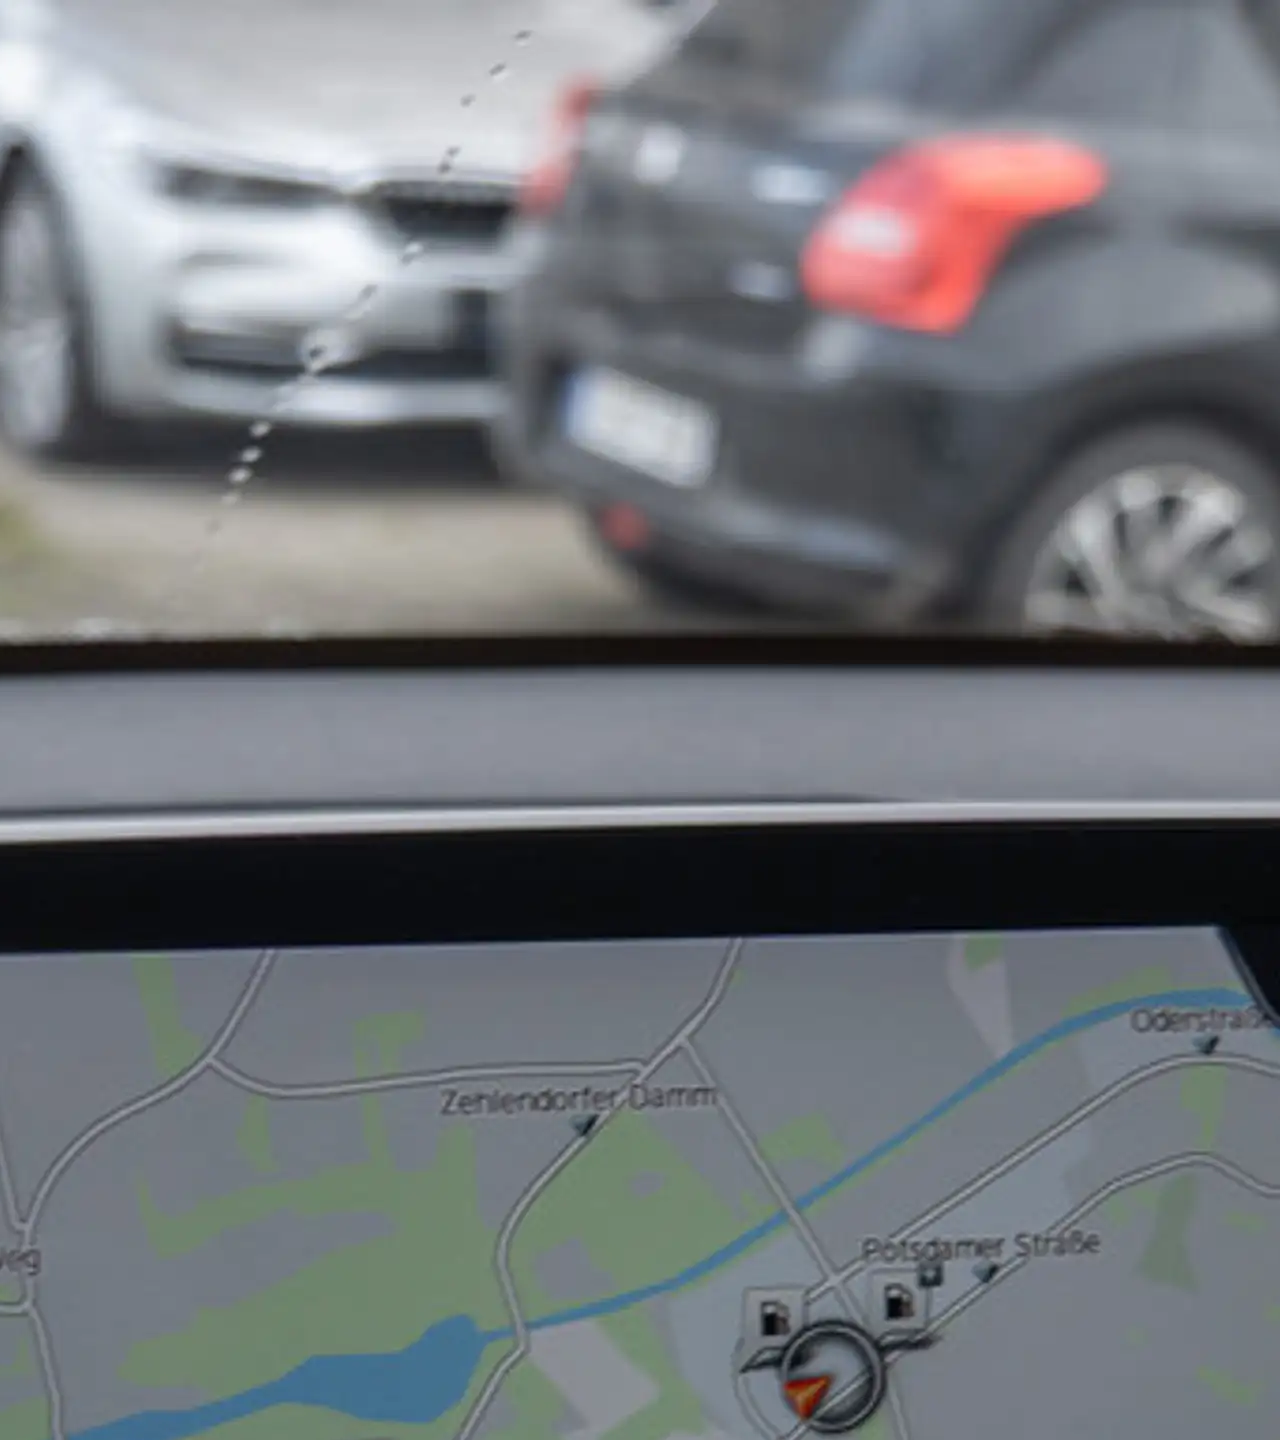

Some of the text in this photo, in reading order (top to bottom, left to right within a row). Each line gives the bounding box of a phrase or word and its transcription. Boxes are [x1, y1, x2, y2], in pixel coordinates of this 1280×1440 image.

[628, 1080, 719, 1110] Damm
[862, 1230, 1103, 1264] Potsdamer Straße
